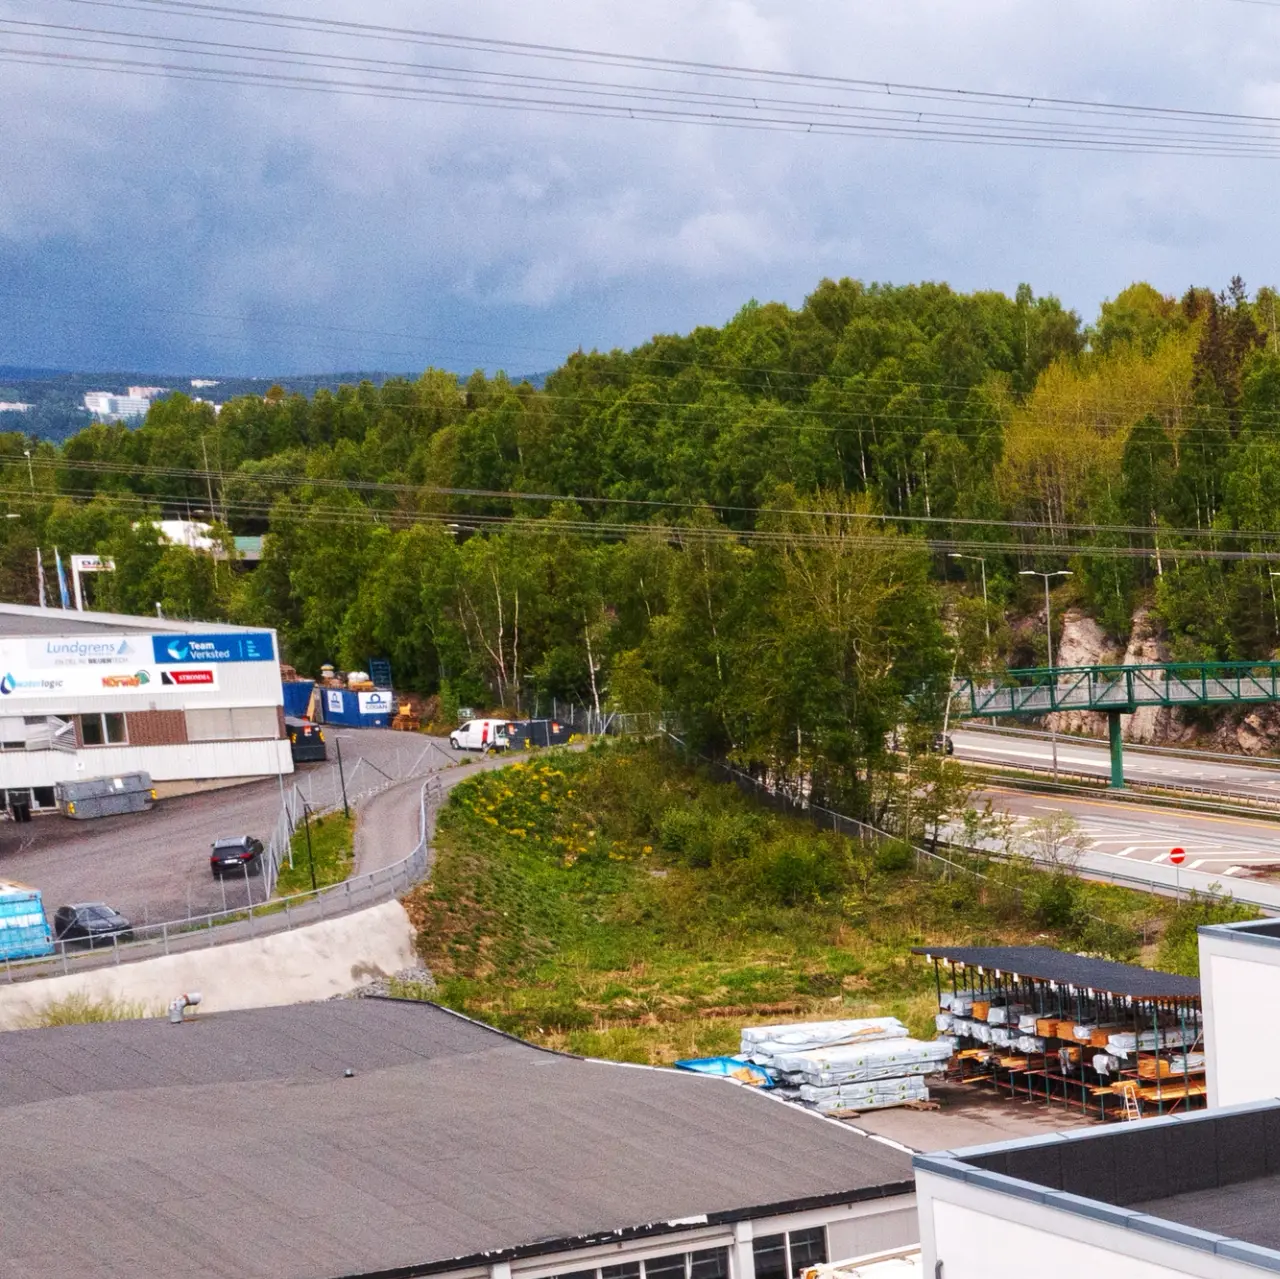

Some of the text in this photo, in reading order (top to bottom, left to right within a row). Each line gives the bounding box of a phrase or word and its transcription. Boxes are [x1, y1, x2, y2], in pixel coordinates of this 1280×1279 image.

[47, 641, 115, 656] Lundgrens
[189, 641, 215, 650] Team
[190, 649, 230, 659] Verksted
